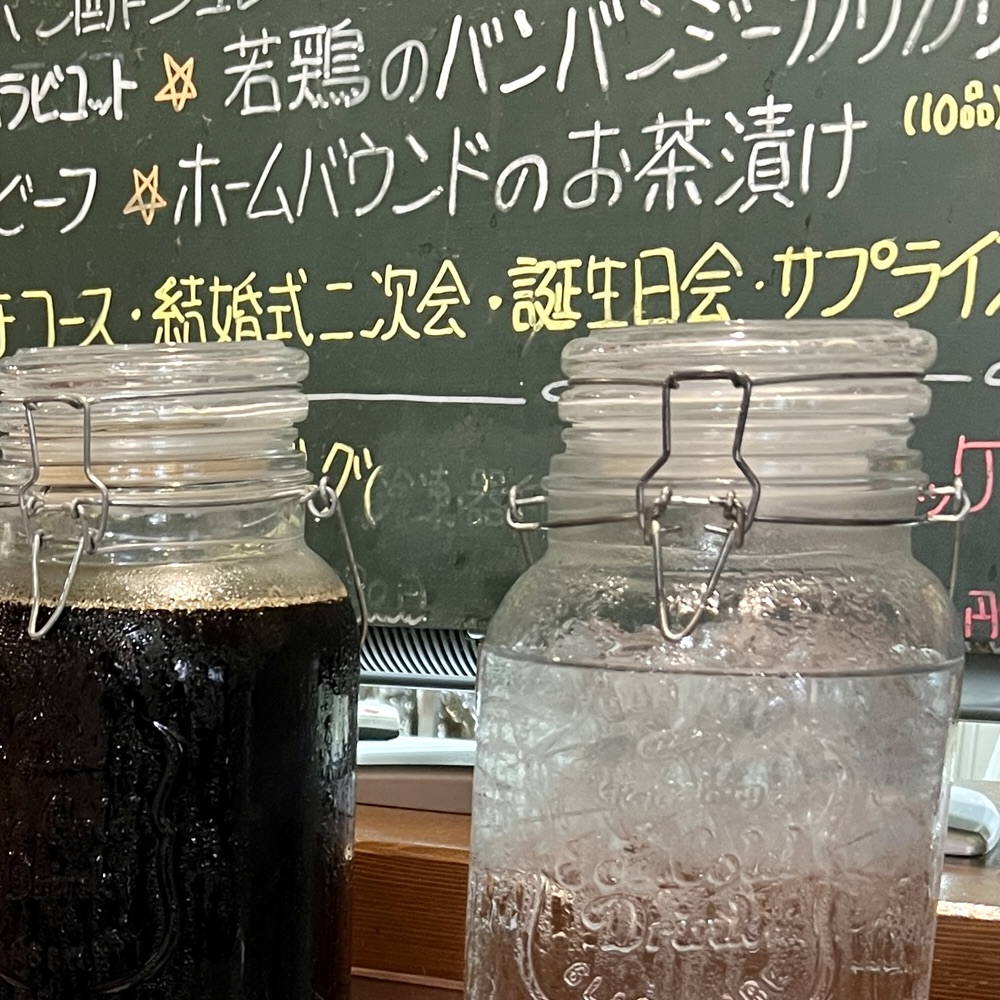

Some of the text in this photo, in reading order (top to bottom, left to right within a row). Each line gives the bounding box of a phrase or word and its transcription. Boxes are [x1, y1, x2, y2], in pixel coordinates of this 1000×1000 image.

[173, 95, 868, 228] ホームバウンドのお茶漬け
